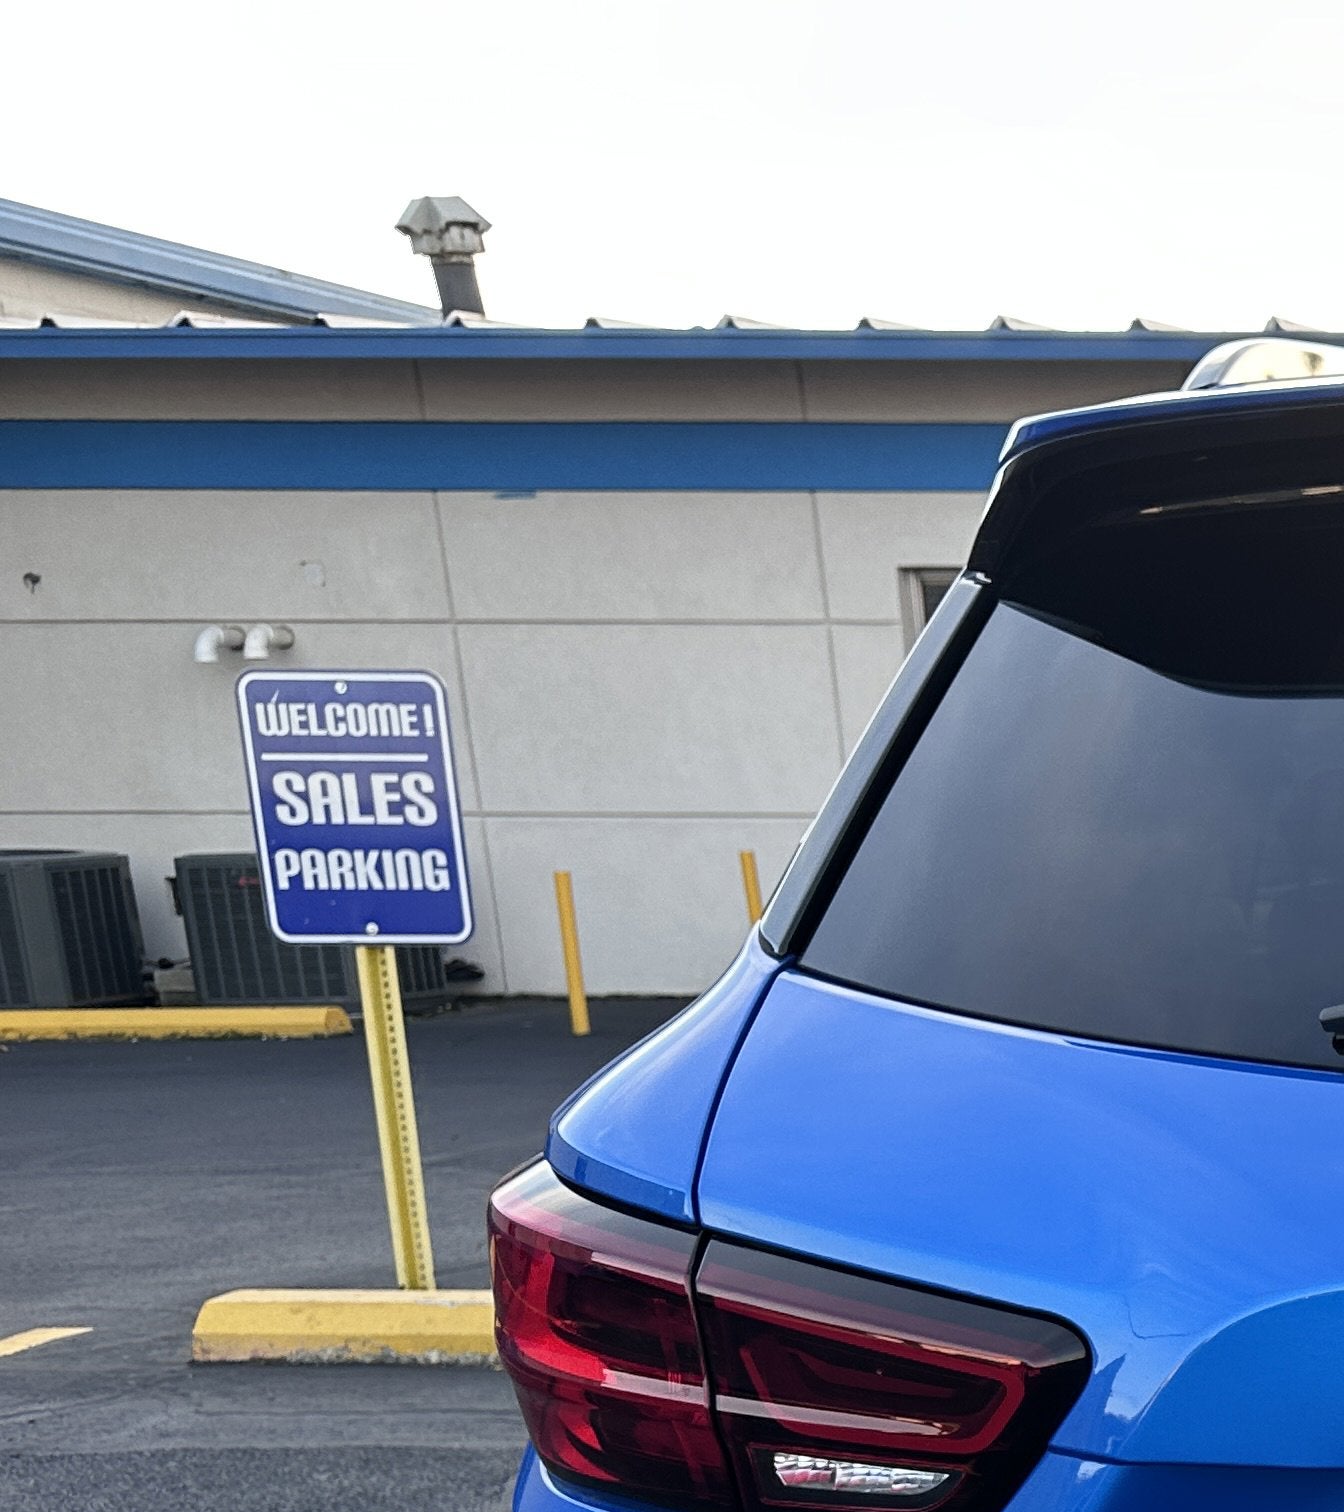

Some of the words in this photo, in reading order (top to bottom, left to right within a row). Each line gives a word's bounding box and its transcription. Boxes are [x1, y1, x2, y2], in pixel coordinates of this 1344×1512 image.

[255, 696, 435, 736] WELCOME!
[272, 771, 438, 827] SALES
[274, 848, 450, 891] PARKING
